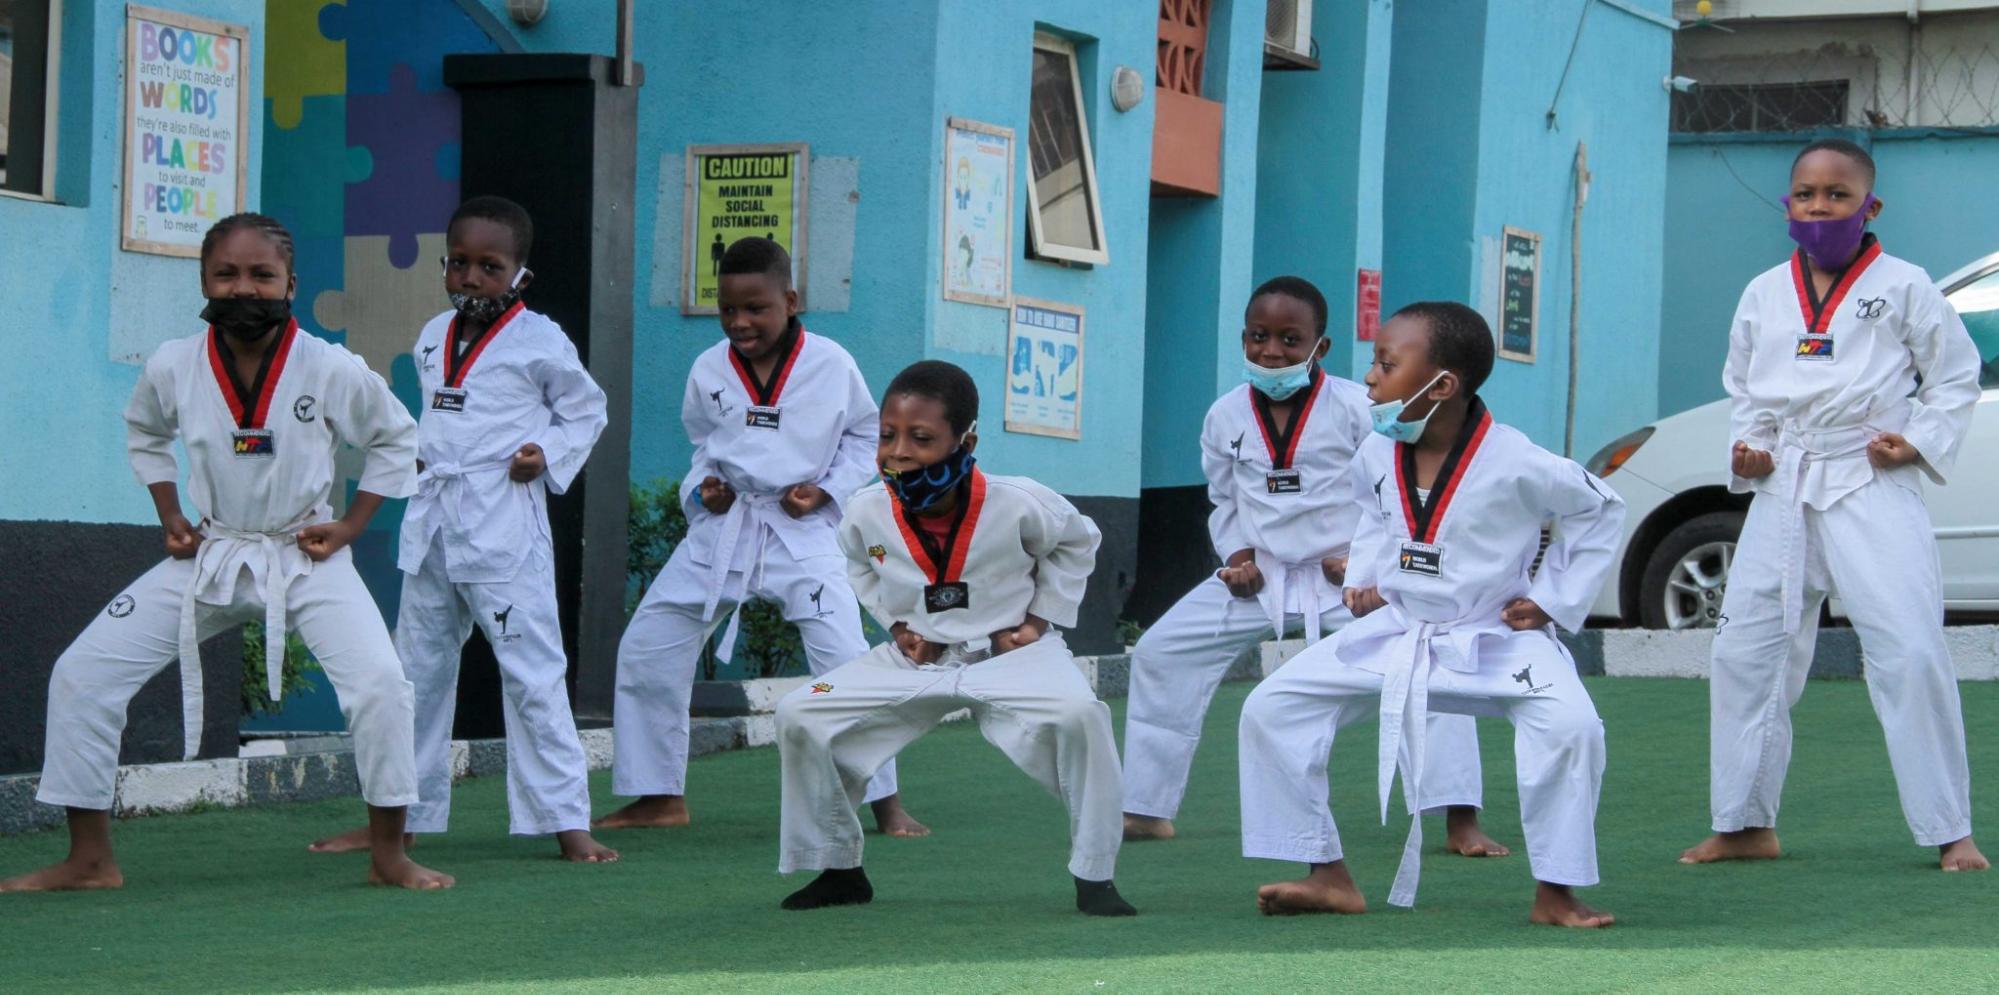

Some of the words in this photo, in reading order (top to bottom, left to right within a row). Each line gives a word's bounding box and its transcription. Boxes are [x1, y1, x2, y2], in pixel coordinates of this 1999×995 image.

[142, 23, 229, 72] BOOKS
[140, 62, 170, 78] aren't
[173, 66, 192, 81] just
[194, 71, 222, 86] made
[224, 73, 236, 88] of
[140, 80, 218, 120] WORDS
[136, 117, 168, 131] they're
[170, 120, 187, 134] also
[189, 123, 209, 137] filled
[212, 128, 232, 141] with
[142, 132, 225, 175] PLACES
[709, 156, 784, 178] CAUTION
[159, 171, 168, 181] to
[170, 172, 187, 185] visit
[190, 174, 205, 187] and
[144, 182, 216, 221] PEOPLE
[719, 185, 772, 198] MAINTAIN
[726, 200, 765, 213] SOCIAL
[164, 219, 173, 229] to
[712, 214, 778, 229] DISTANCING
